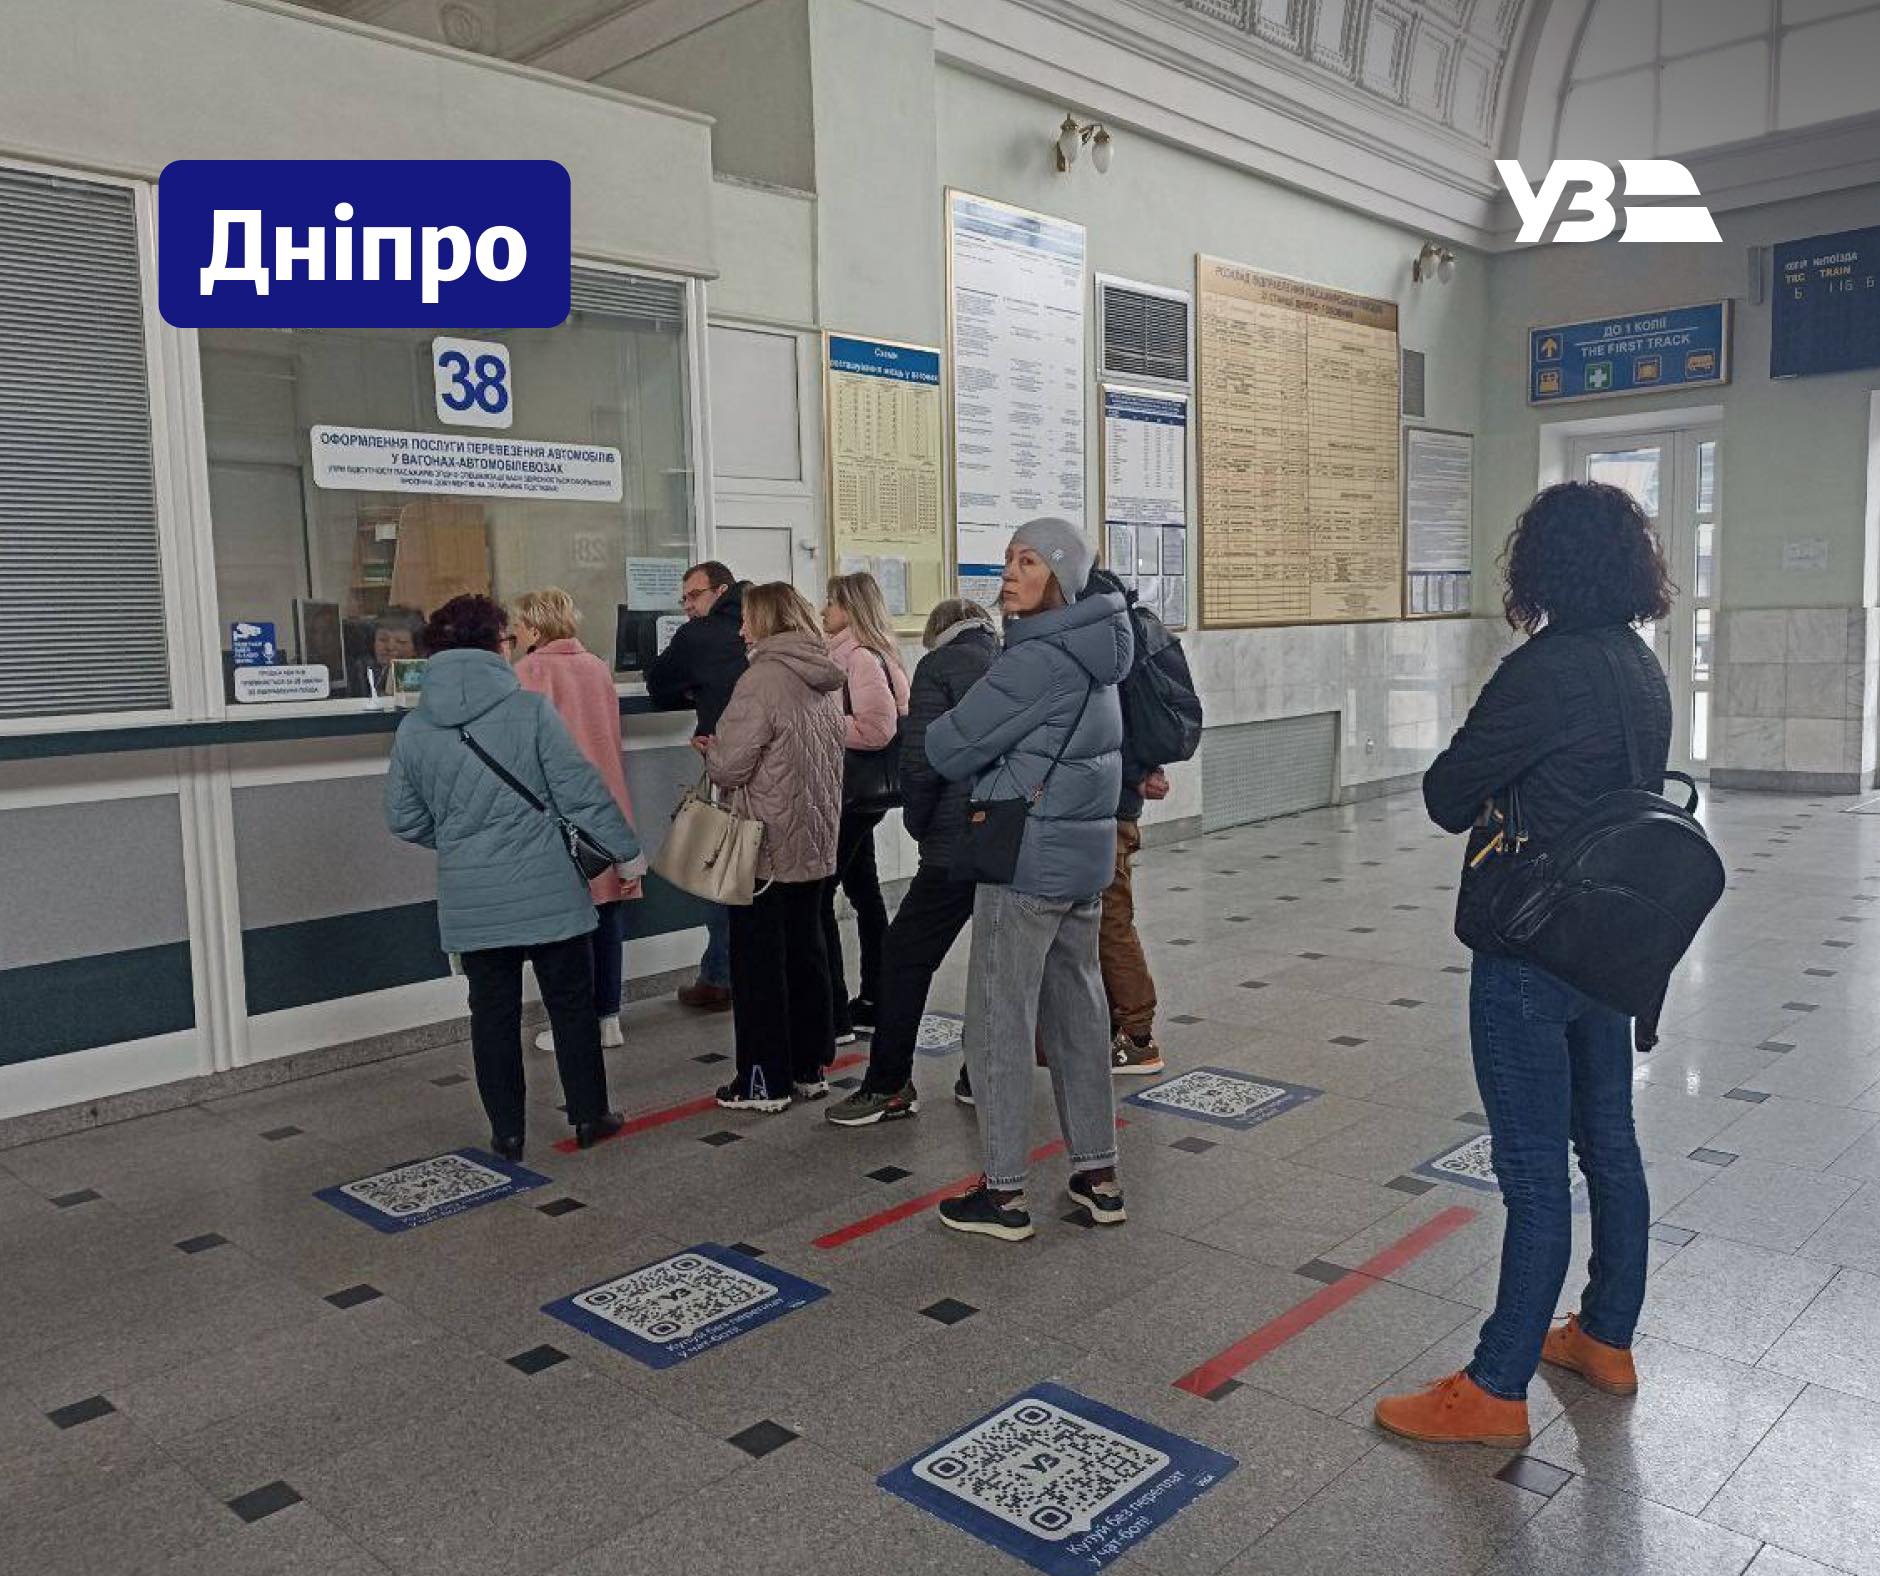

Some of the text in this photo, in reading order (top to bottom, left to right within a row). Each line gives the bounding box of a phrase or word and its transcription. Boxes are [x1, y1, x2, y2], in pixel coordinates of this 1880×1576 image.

[1820, 265, 1851, 278] TRAIN
[1602, 324, 1621, 338] ДО
[1580, 333, 1691, 358] THE FIRST TRACK
[437, 351, 509, 414] 38
[320, 431, 616, 464] ОФОРМЛЕННЯ ПОСЛУГИ ПЕРЕВЕЗЕННЯ АВТОМОБІЛІВ
[391, 453, 564, 475] У ВАГОНАХ-АВТОМОБІЛЕВОЗАХ
[1019, 1452, 1062, 1474] УЗ
[1065, 1523, 1112, 1556] Купуй
[1104, 1507, 1133, 1527] без
[1129, 1470, 1186, 1512] переплат
